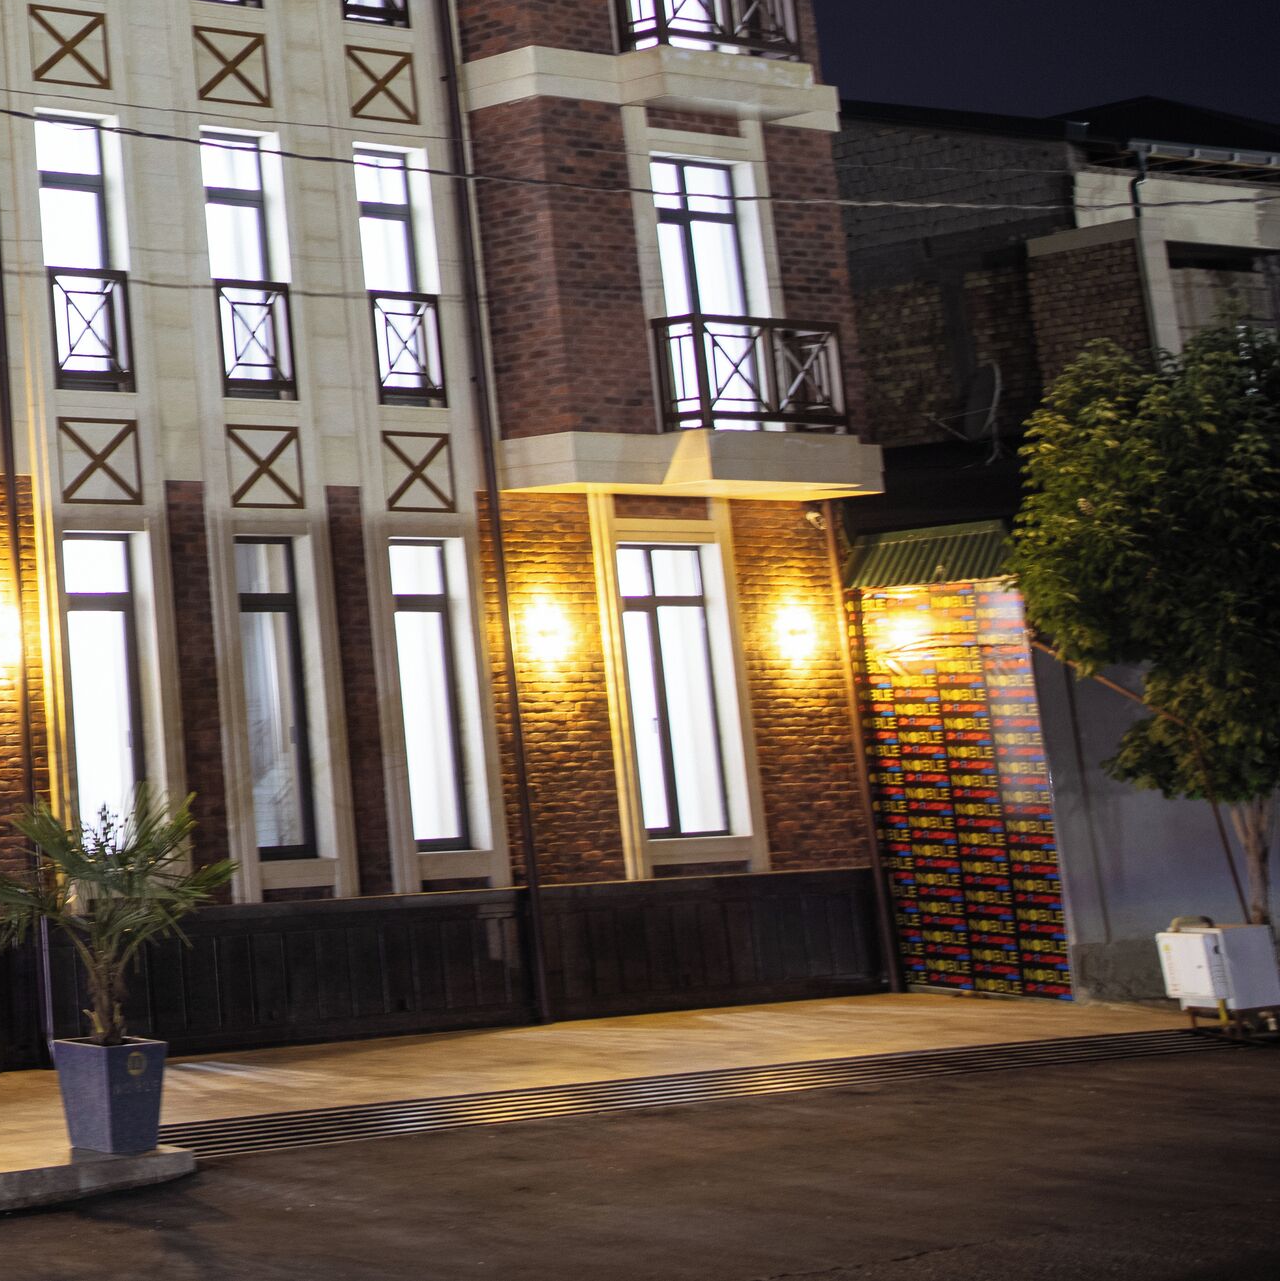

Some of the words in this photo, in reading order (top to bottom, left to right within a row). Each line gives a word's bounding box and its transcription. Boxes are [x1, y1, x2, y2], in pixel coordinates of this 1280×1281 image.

[930, 595, 976, 608] NOBLE
[936, 661, 983, 674] NOBLE
[891, 675, 938, 687] NOBLE
[940, 689, 987, 702] NOBLE
[894, 703, 940, 716] NOBLE
[944, 718, 990, 730] NOBLE
[898, 732, 944, 744] NOBLE
[947, 746, 995, 759] NOBLE
[901, 760, 948, 772] NOBLE
[951, 775, 999, 788] NOBLE
[905, 788, 951, 800] NOBLE
[955, 803, 1002, 816] NOBLE
[908, 816, 954, 829] NOBLE
[958, 833, 1007, 846] NOBLE
[912, 844, 958, 858] NOBLE
[961, 861, 1010, 875] NOBLE
[915, 873, 961, 886] NOBLE
[965, 890, 1013, 905] NOBLE
[918, 901, 964, 915] NOBLE
[968, 919, 1016, 934] NOBLE
[922, 930, 968, 944] NOBLE
[971, 948, 1020, 964] NOBLE
[926, 960, 972, 974] NOBLE
[975, 978, 1023, 994] NOBLE
